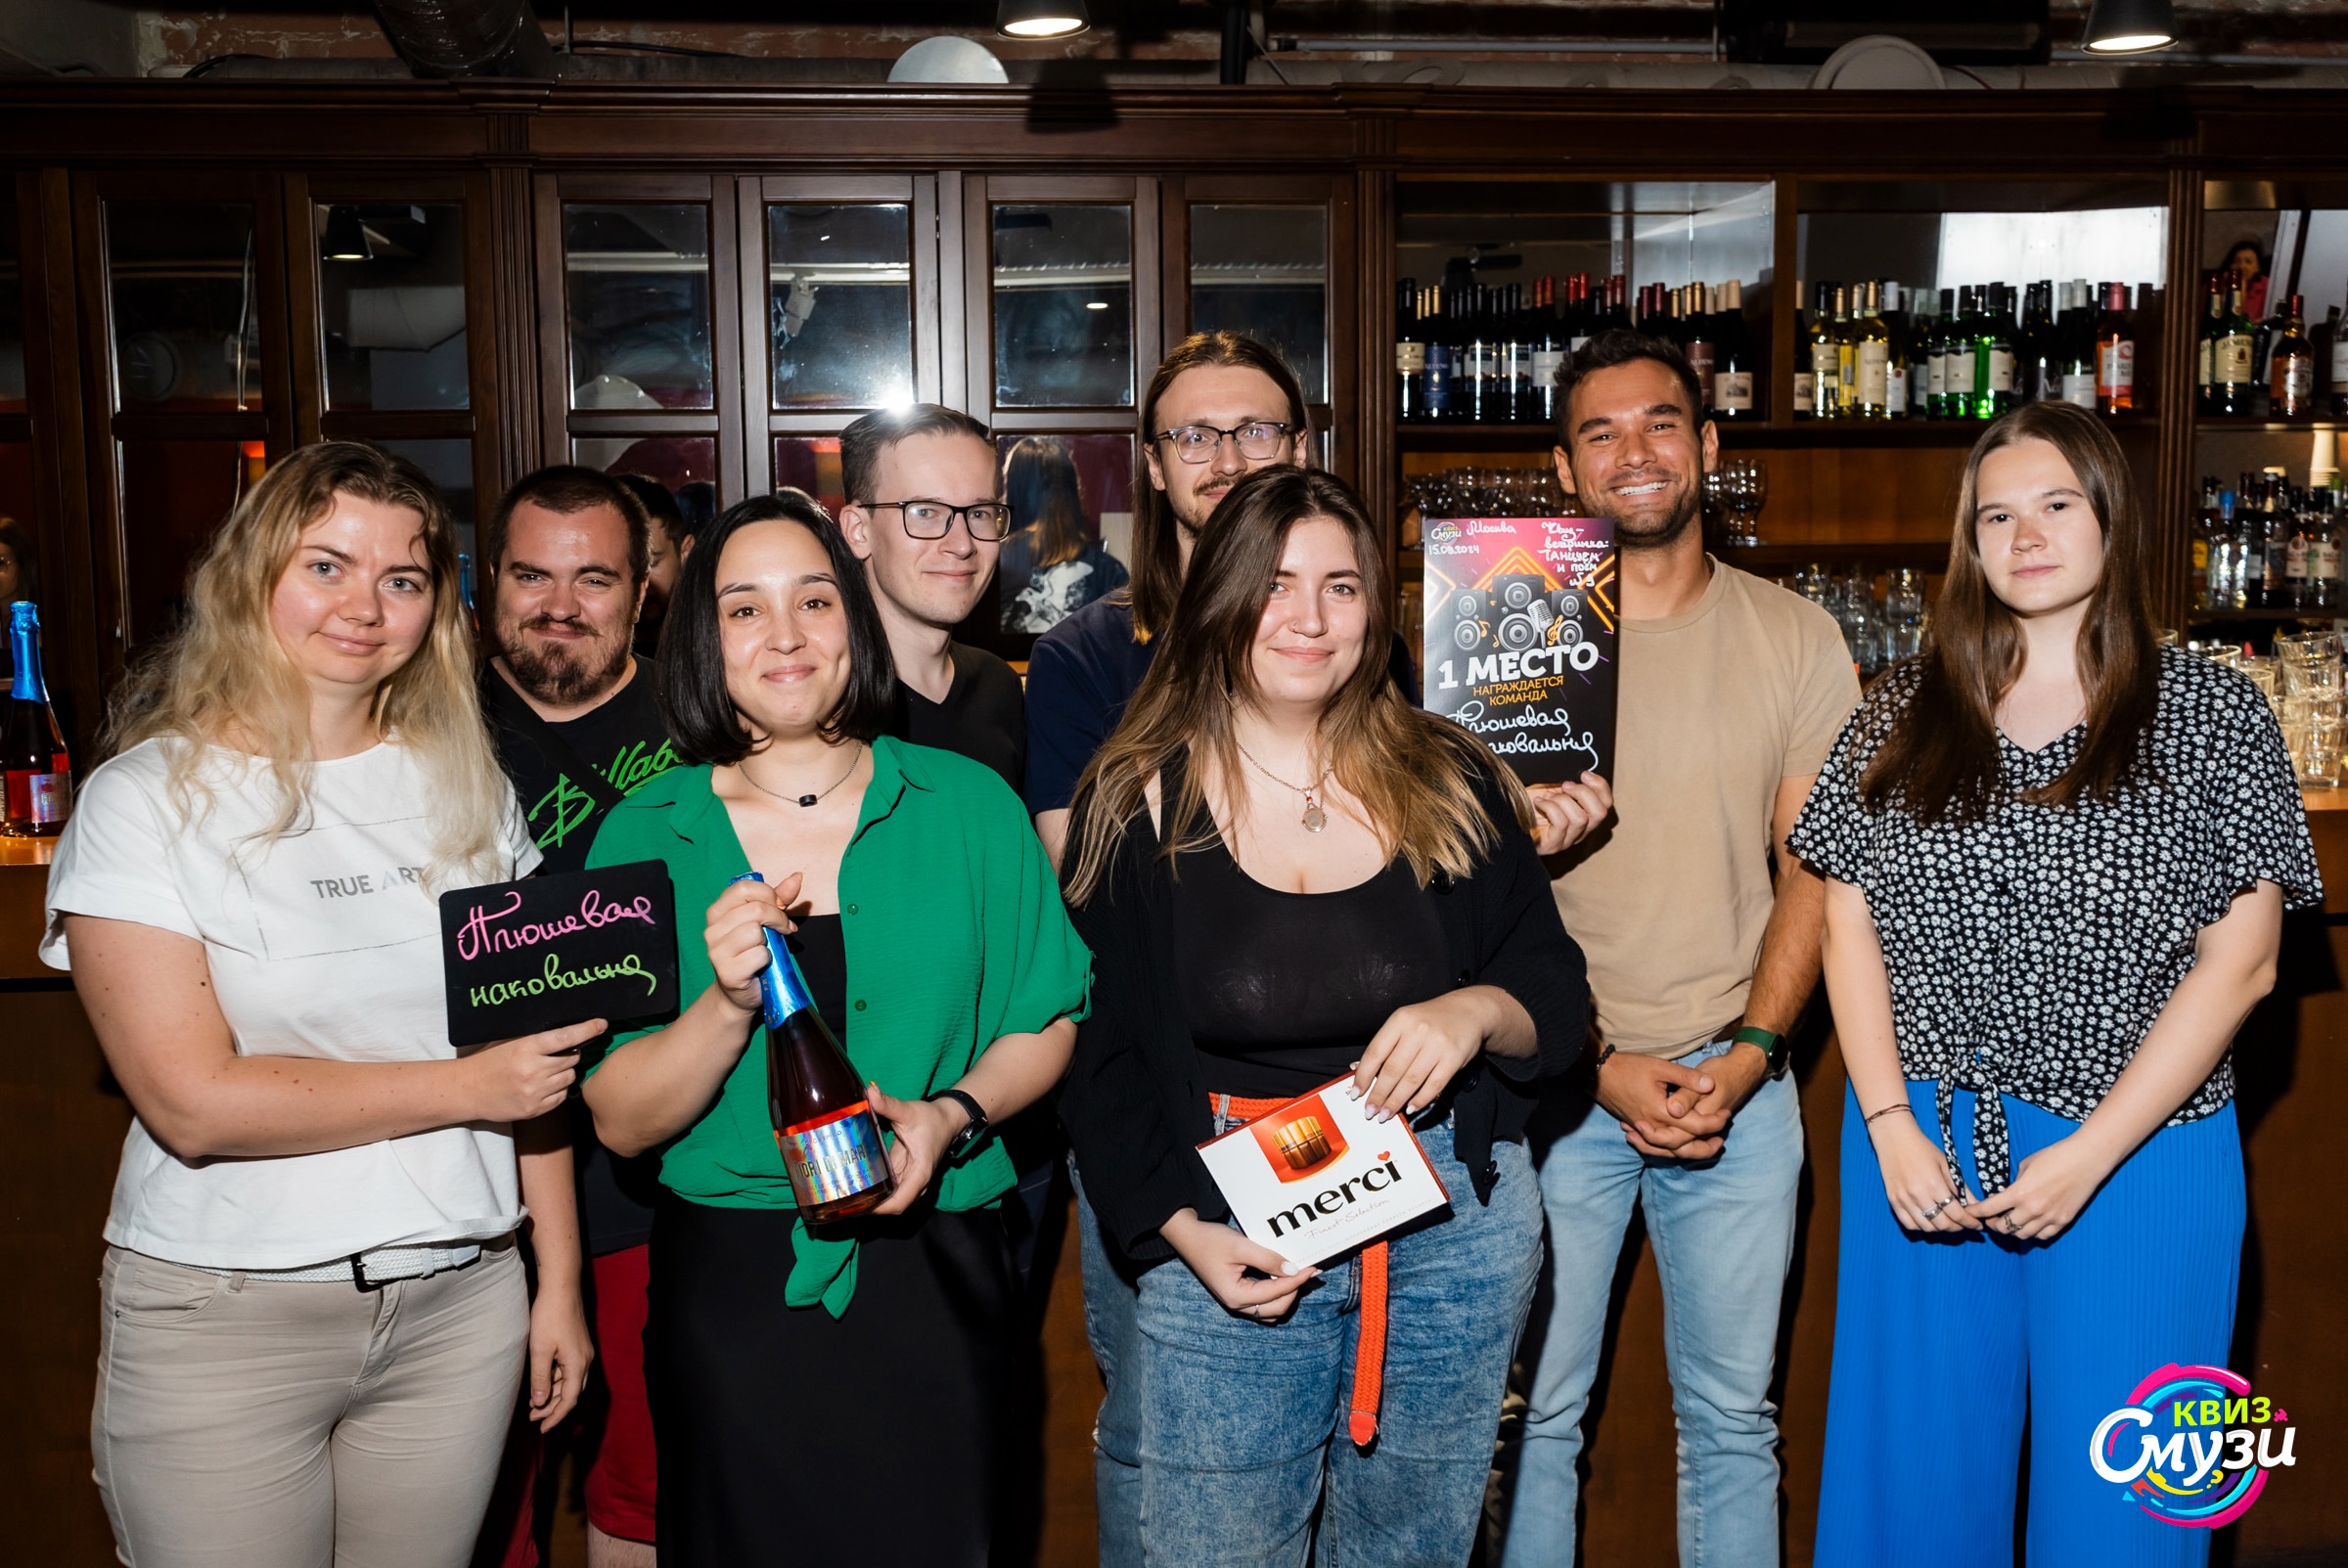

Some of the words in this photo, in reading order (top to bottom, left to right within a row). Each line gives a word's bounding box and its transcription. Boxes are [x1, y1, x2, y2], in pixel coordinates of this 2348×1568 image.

[1431, 528, 1462, 540] Смузи
[1467, 520, 1516, 536] Москва
[1438, 659, 1459, 690] 1
[1466, 641, 1600, 687] МЕСТО
[1472, 675, 1564, 697] НАГРАЖДАЕТСЯ
[1489, 690, 1549, 706] КОМАНДА
[310, 874, 374, 899] TRUE
[457, 891, 656, 961] Плюшевая
[471, 953, 656, 1008] наковальня
[1266, 1150, 1403, 1238] merci
[1345, 1199, 1391, 1223] Selection
